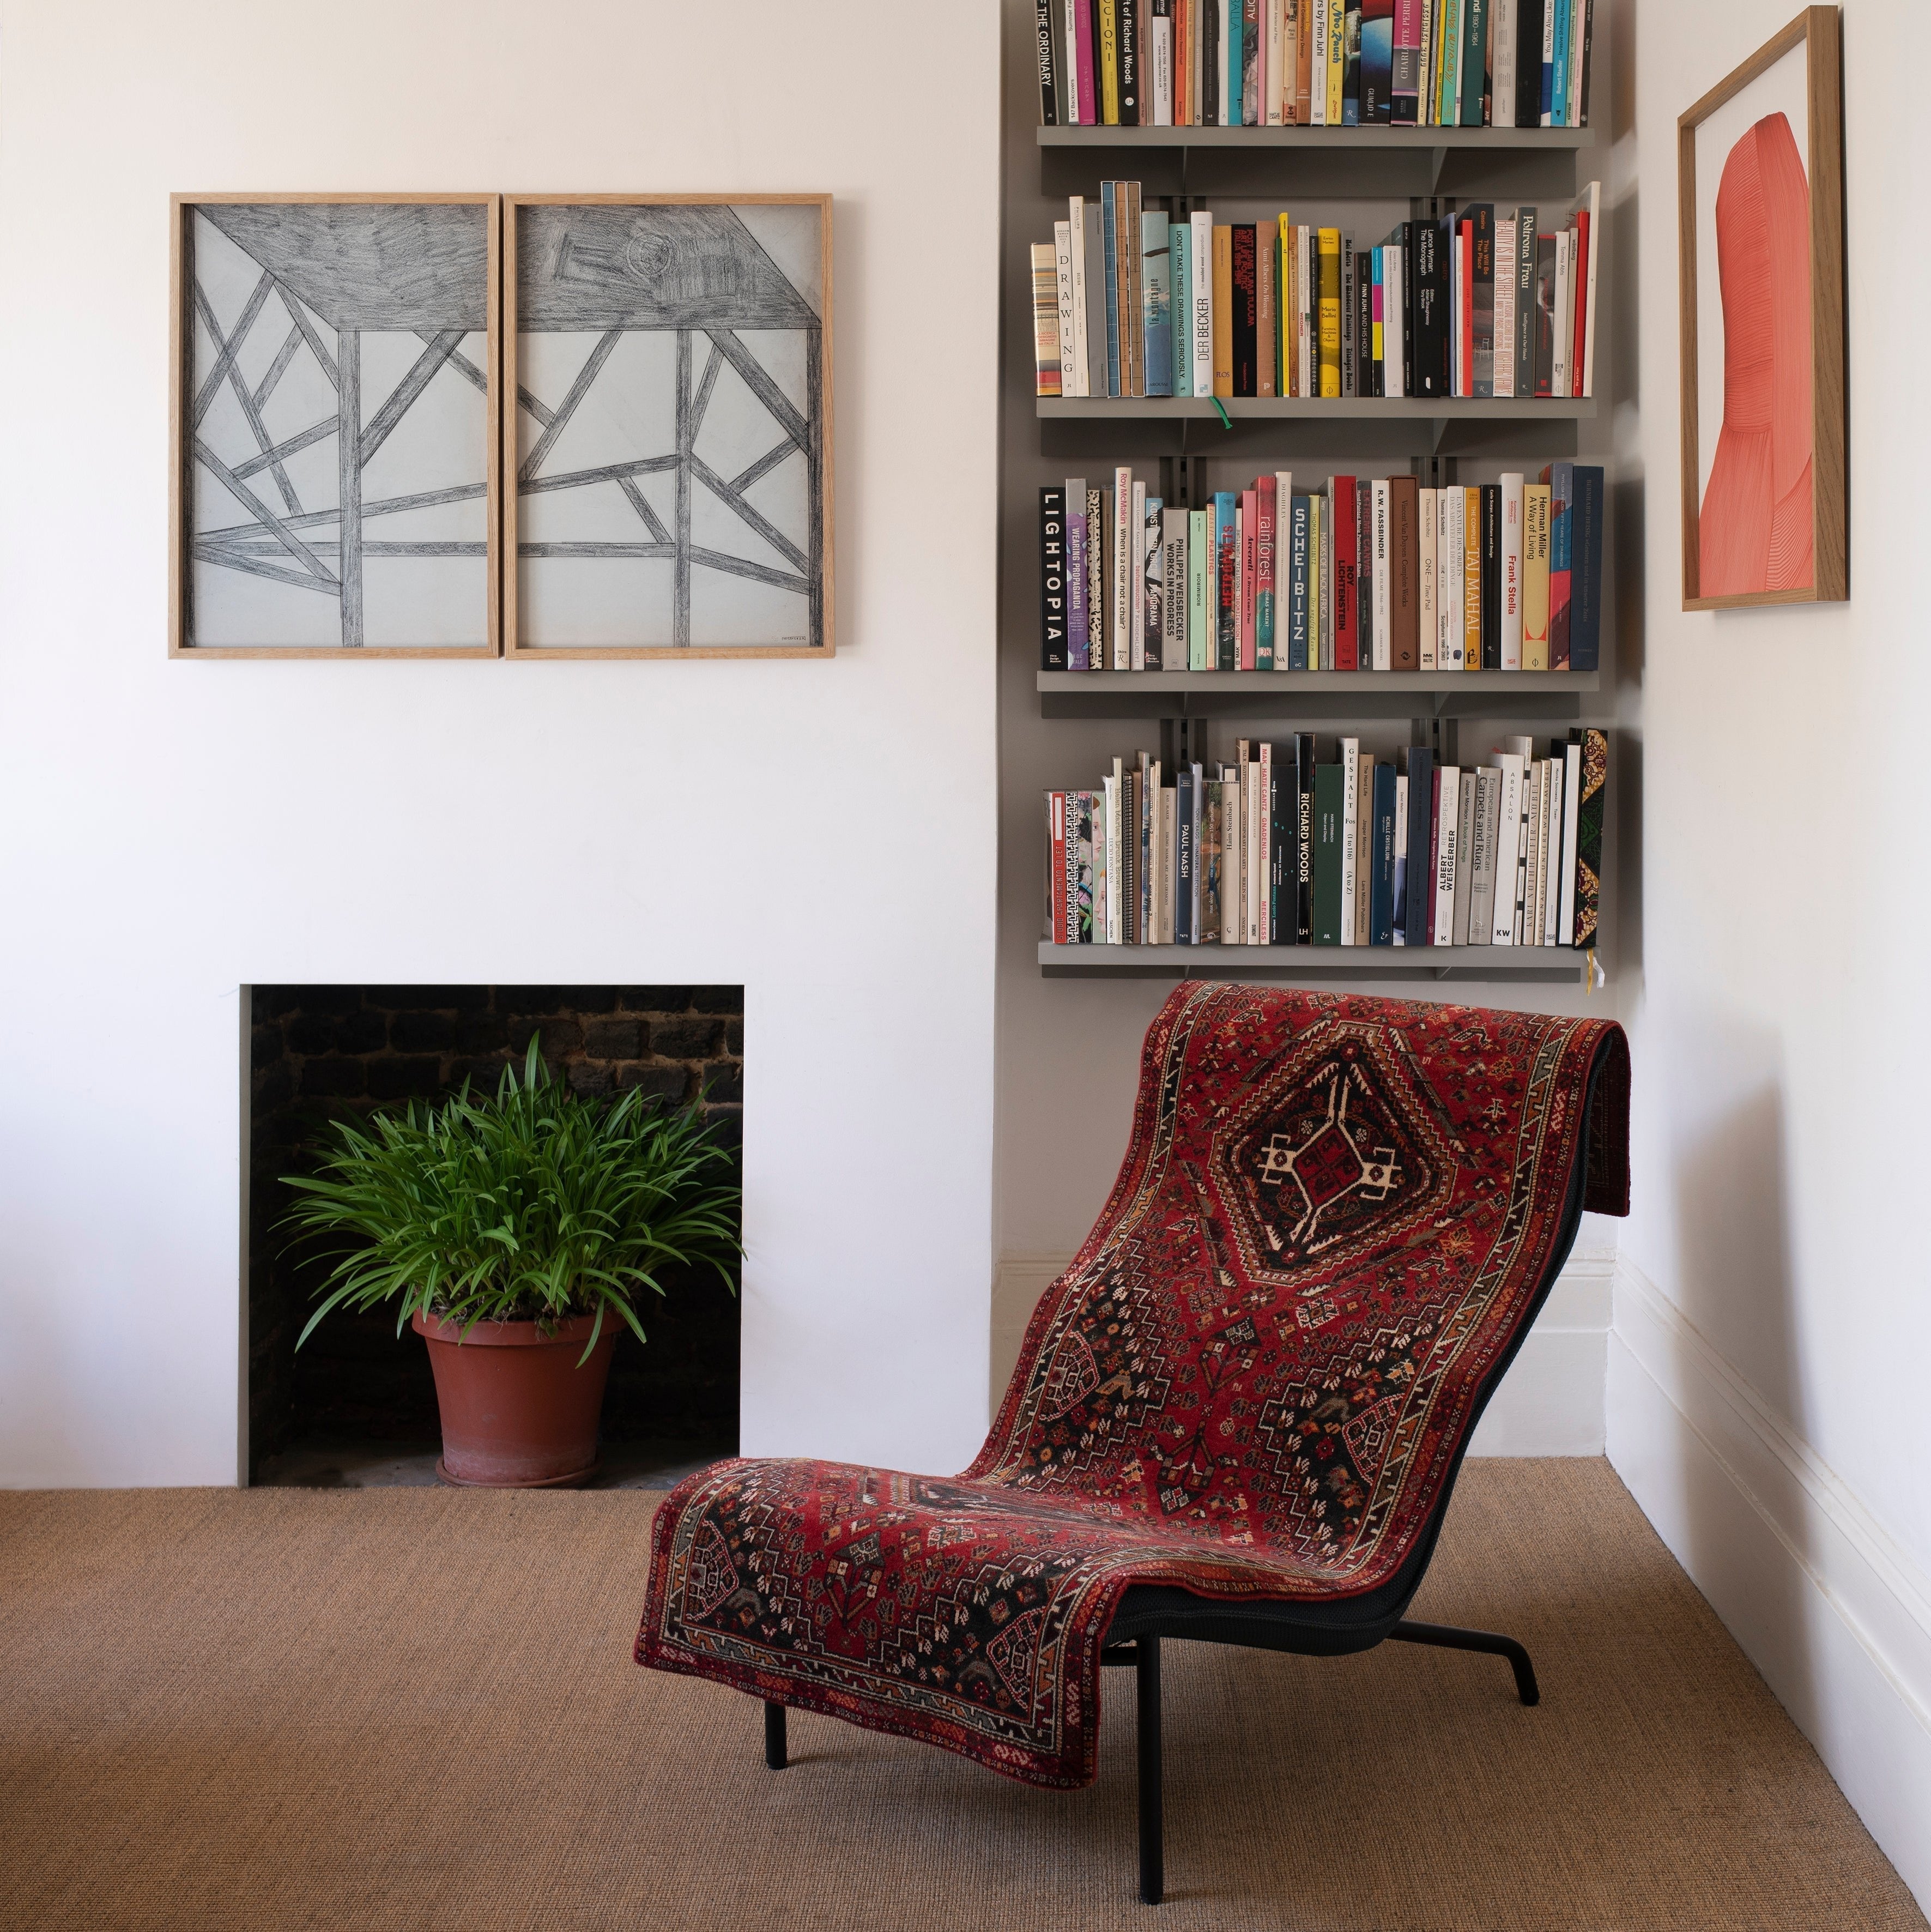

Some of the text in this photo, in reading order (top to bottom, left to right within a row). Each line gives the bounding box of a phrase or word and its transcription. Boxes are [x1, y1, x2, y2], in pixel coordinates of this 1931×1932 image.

[1316, 10, 1324, 19] by
[1331, 3, 1342, 63] Neo Rauch
[1038, 7, 1051, 86] THE ORDINARY
[1123, 8, 1133, 84] of Richard Woods
[1401, 28, 1409, 79] CHARLOTTE
[1496, 221, 1514, 245] BEAUTY
[1521, 216, 1533, 288] Poltrona Frau
[1263, 285, 1269, 293] On
[1484, 267, 1488, 275] Be
[1496, 263, 1514, 275] THE
[1496, 277, 1514, 300] STREET
[1059, 256, 1073, 372] DRAWING
[1150, 279, 1160, 315] montagne
[1197, 299, 1209, 360] DER BECKER
[1528, 504, 1536, 522] Way
[1529, 524, 1536, 533] of
[1538, 497, 1547, 558] Herman Miller
[1045, 494, 1061, 639] LIGHTOPIA
[1149, 503, 1158, 626] KONSTANTIN GRCIC PANORAMA
[1260, 516, 1273, 581] rainforest
[1321, 558, 1326, 567] OF
[1467, 548, 1479, 572] TAJ
[1527, 535, 1536, 559] Living
[1167, 578, 1174, 587] IN
[1294, 509, 1305, 639] SCHEIBITZ
[1508, 556, 1516, 584] Frank
[1467, 577, 1479, 634] MAHAL
[1486, 778, 1496, 815] European
[1300, 793, 1309, 882] RICHARD WOODS
[1473, 777, 1487, 871] Carpets and Rugs
[1056, 859, 1062, 868] TO
[1447, 831, 1455, 891] WEISGERBER
[1485, 834, 1493, 871] American
[1055, 870, 1063, 915] APARTAMENTO
